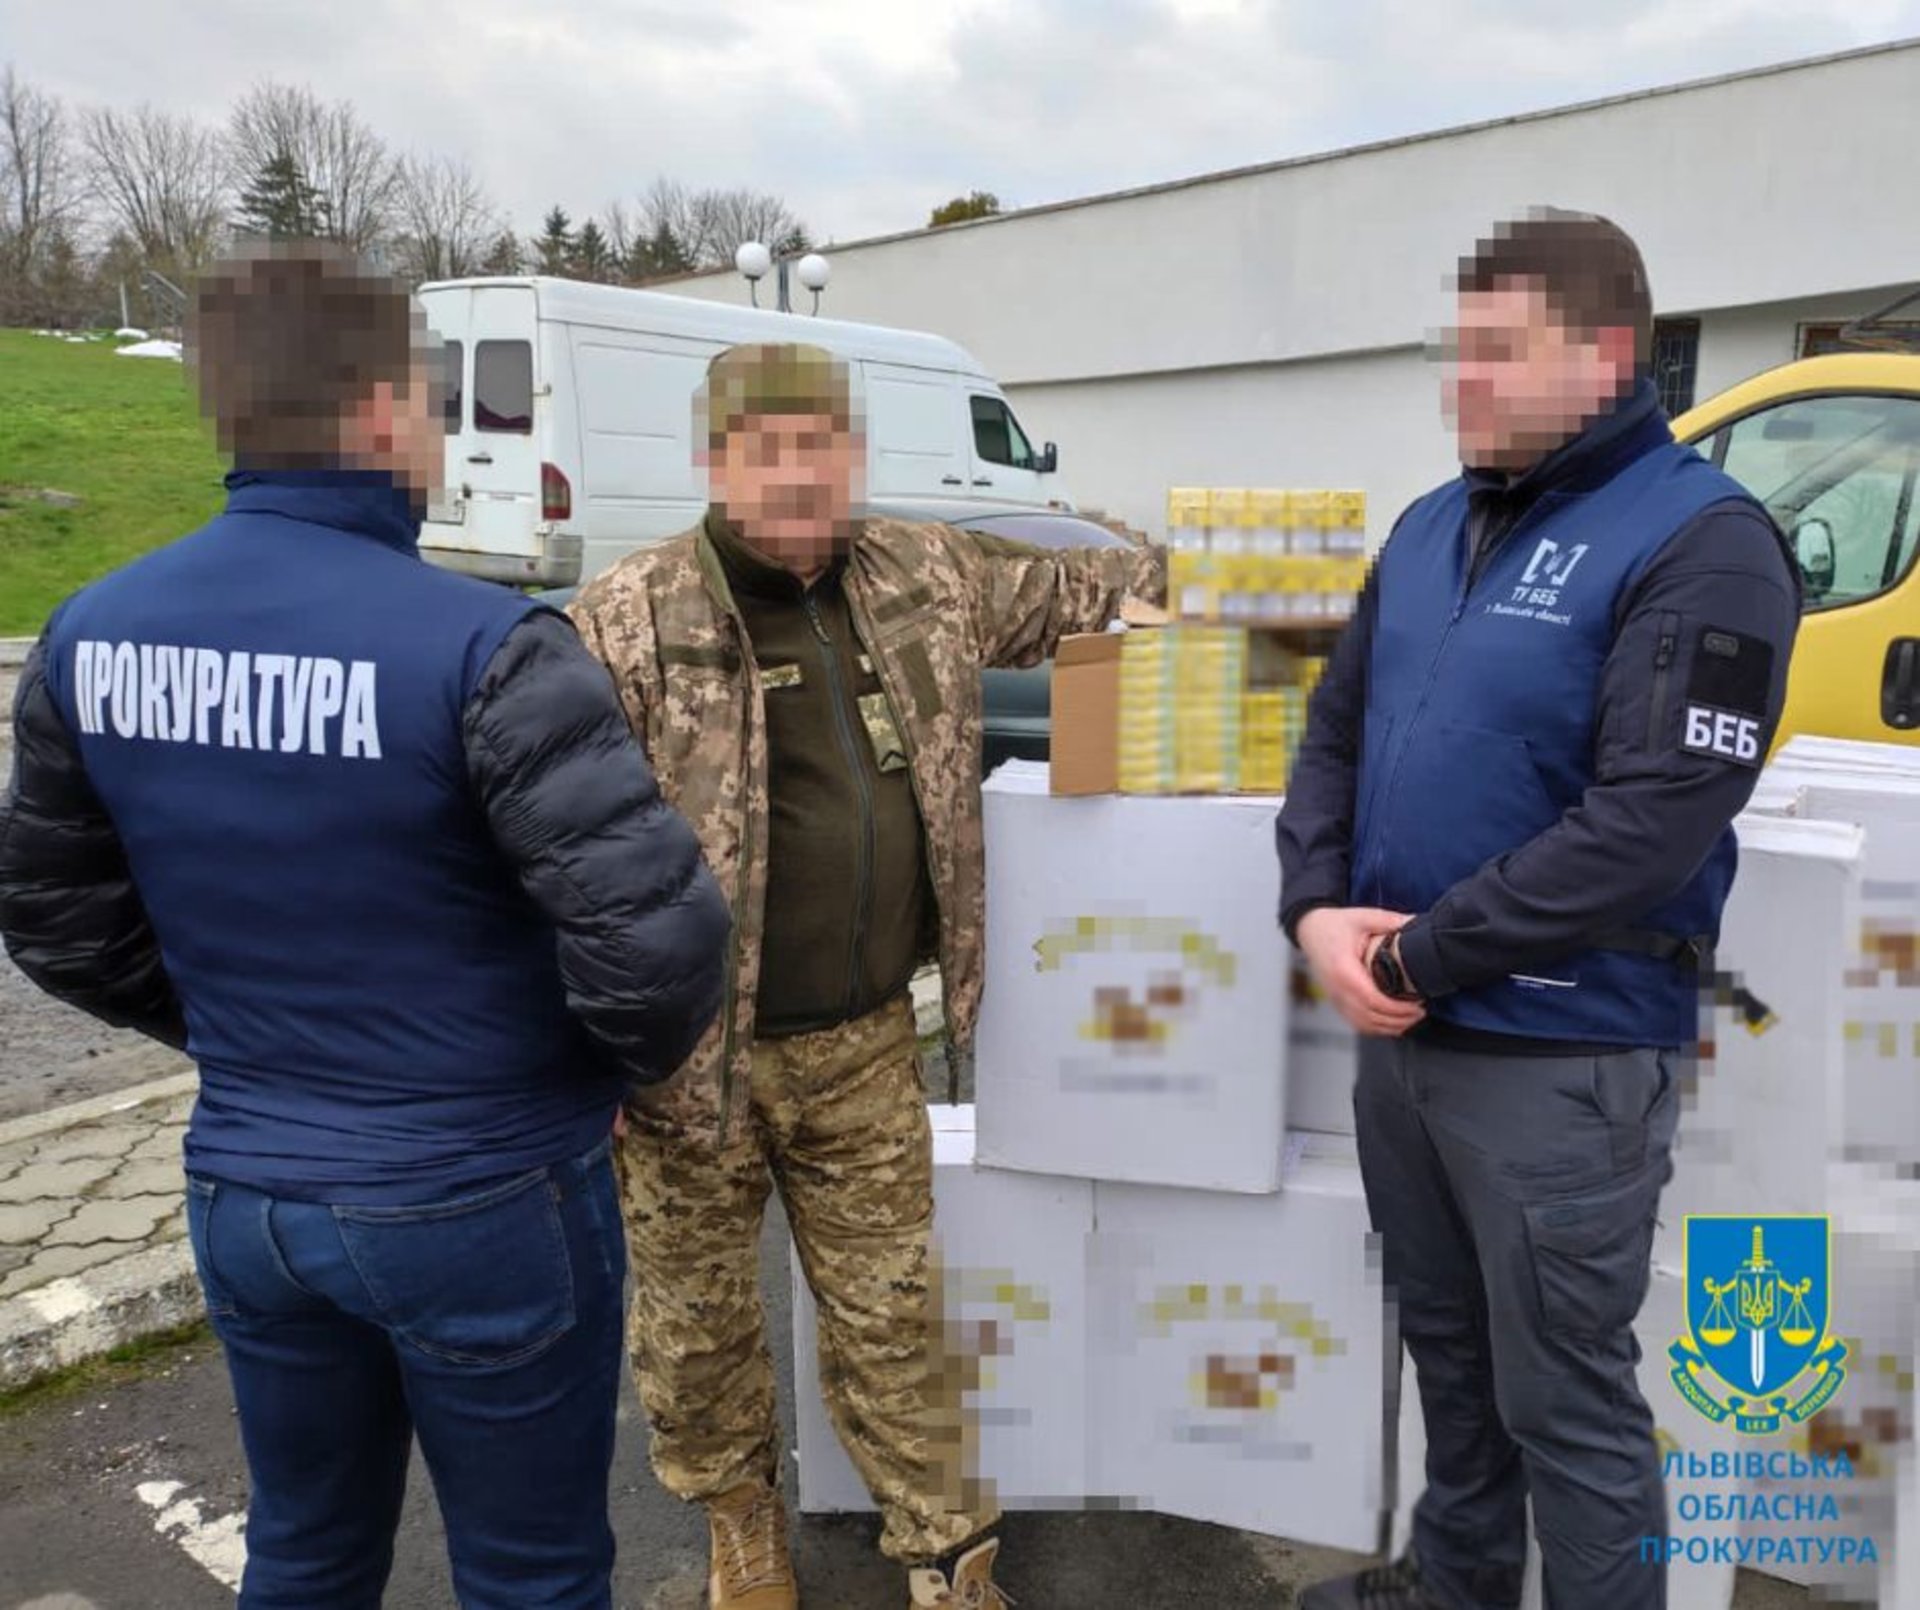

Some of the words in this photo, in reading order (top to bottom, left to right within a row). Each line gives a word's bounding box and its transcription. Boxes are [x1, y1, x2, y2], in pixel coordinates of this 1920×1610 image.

[1528, 586, 1560, 607] БЕБ
[74, 640, 382, 759] ПРОКУРАТУРА
[1684, 706, 1759, 760] БЕБ
